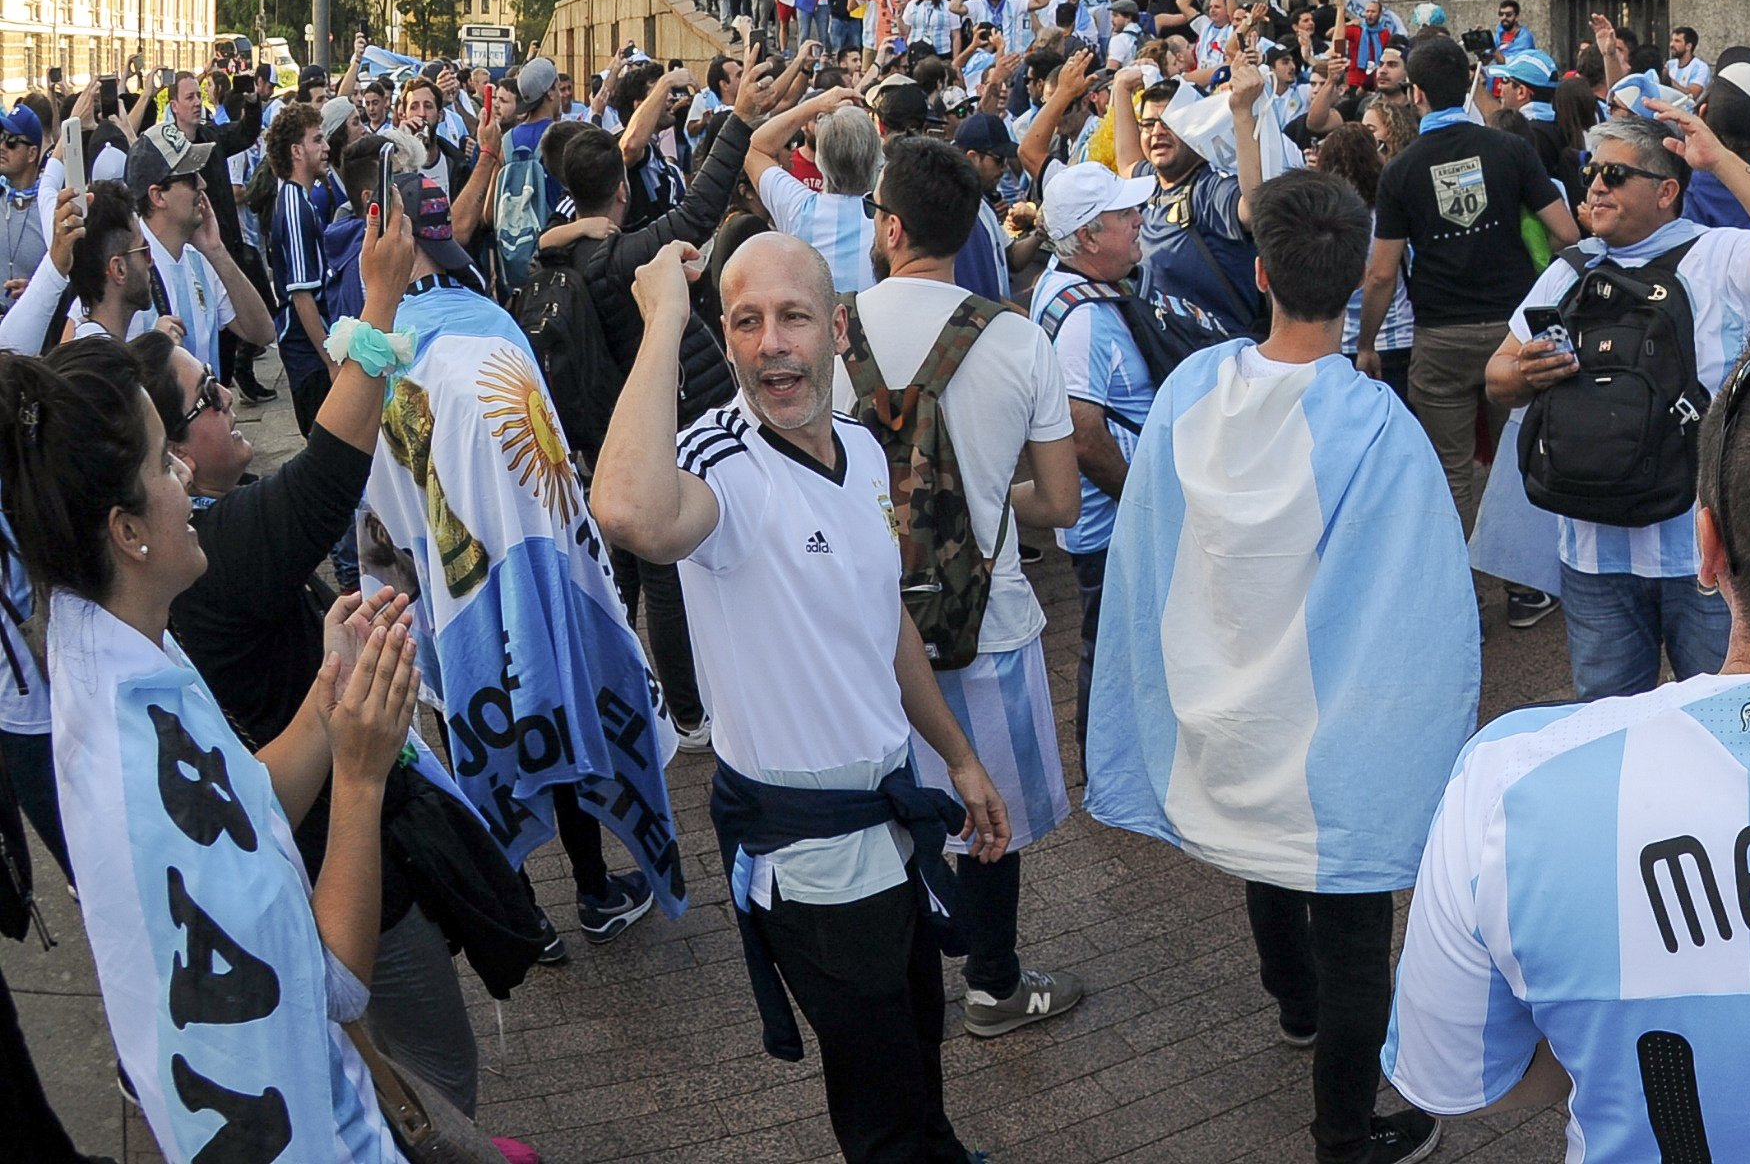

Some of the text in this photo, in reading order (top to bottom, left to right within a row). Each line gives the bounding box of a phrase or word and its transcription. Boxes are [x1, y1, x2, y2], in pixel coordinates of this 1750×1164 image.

[1438, 162, 1477, 177] ARGENTINA
[803, 177, 823, 190] STR
[1448, 193, 1478, 216] 40
[805, 542, 834, 554] adid
[1026, 992, 1051, 1014] N
